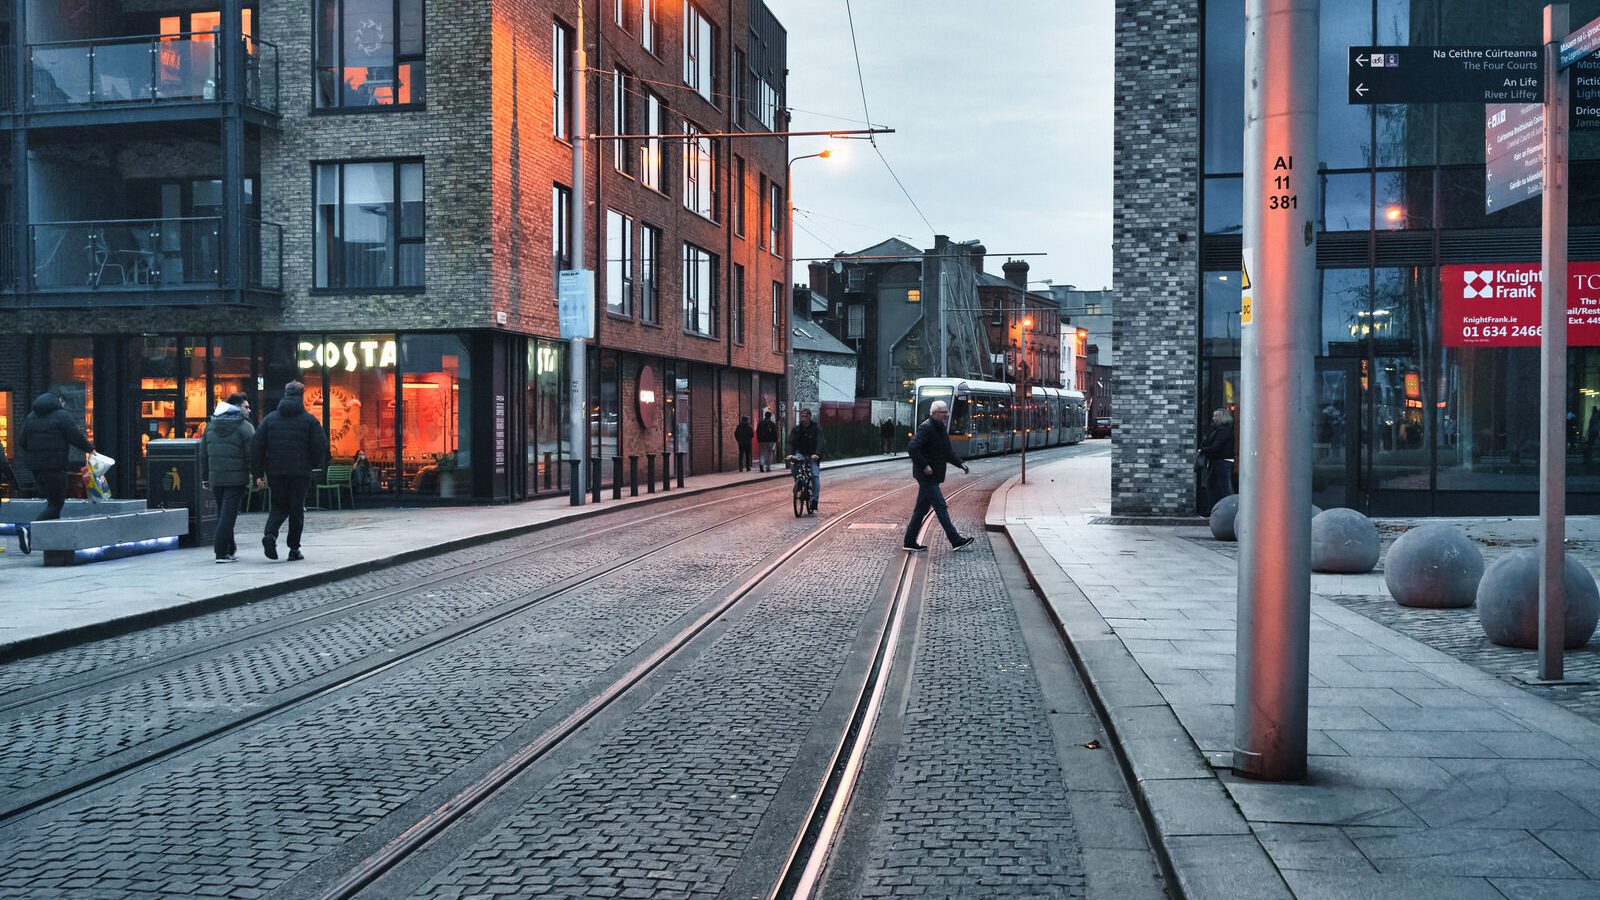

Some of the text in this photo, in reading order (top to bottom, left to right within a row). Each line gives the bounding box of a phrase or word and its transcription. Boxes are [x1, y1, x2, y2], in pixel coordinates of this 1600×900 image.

[1433, 49, 1537, 58] Na Ceithre Cúirteanna
[1464, 60, 1538, 70] The Four Courts
[1503, 77, 1538, 86] An Life
[1484, 90, 1537, 100] River Liffey
[1274, 176, 1290, 190] 11
[1269, 195, 1298, 210] 381
[1496, 285, 1536, 298] Frank
[1580, 297, 1597, 305] The
[1463, 316, 1518, 324] KnightFrank.ie
[1463, 326, 1480, 337] 01
[1482, 326, 1507, 337] 634
[297, 340, 396, 372] COSTA
